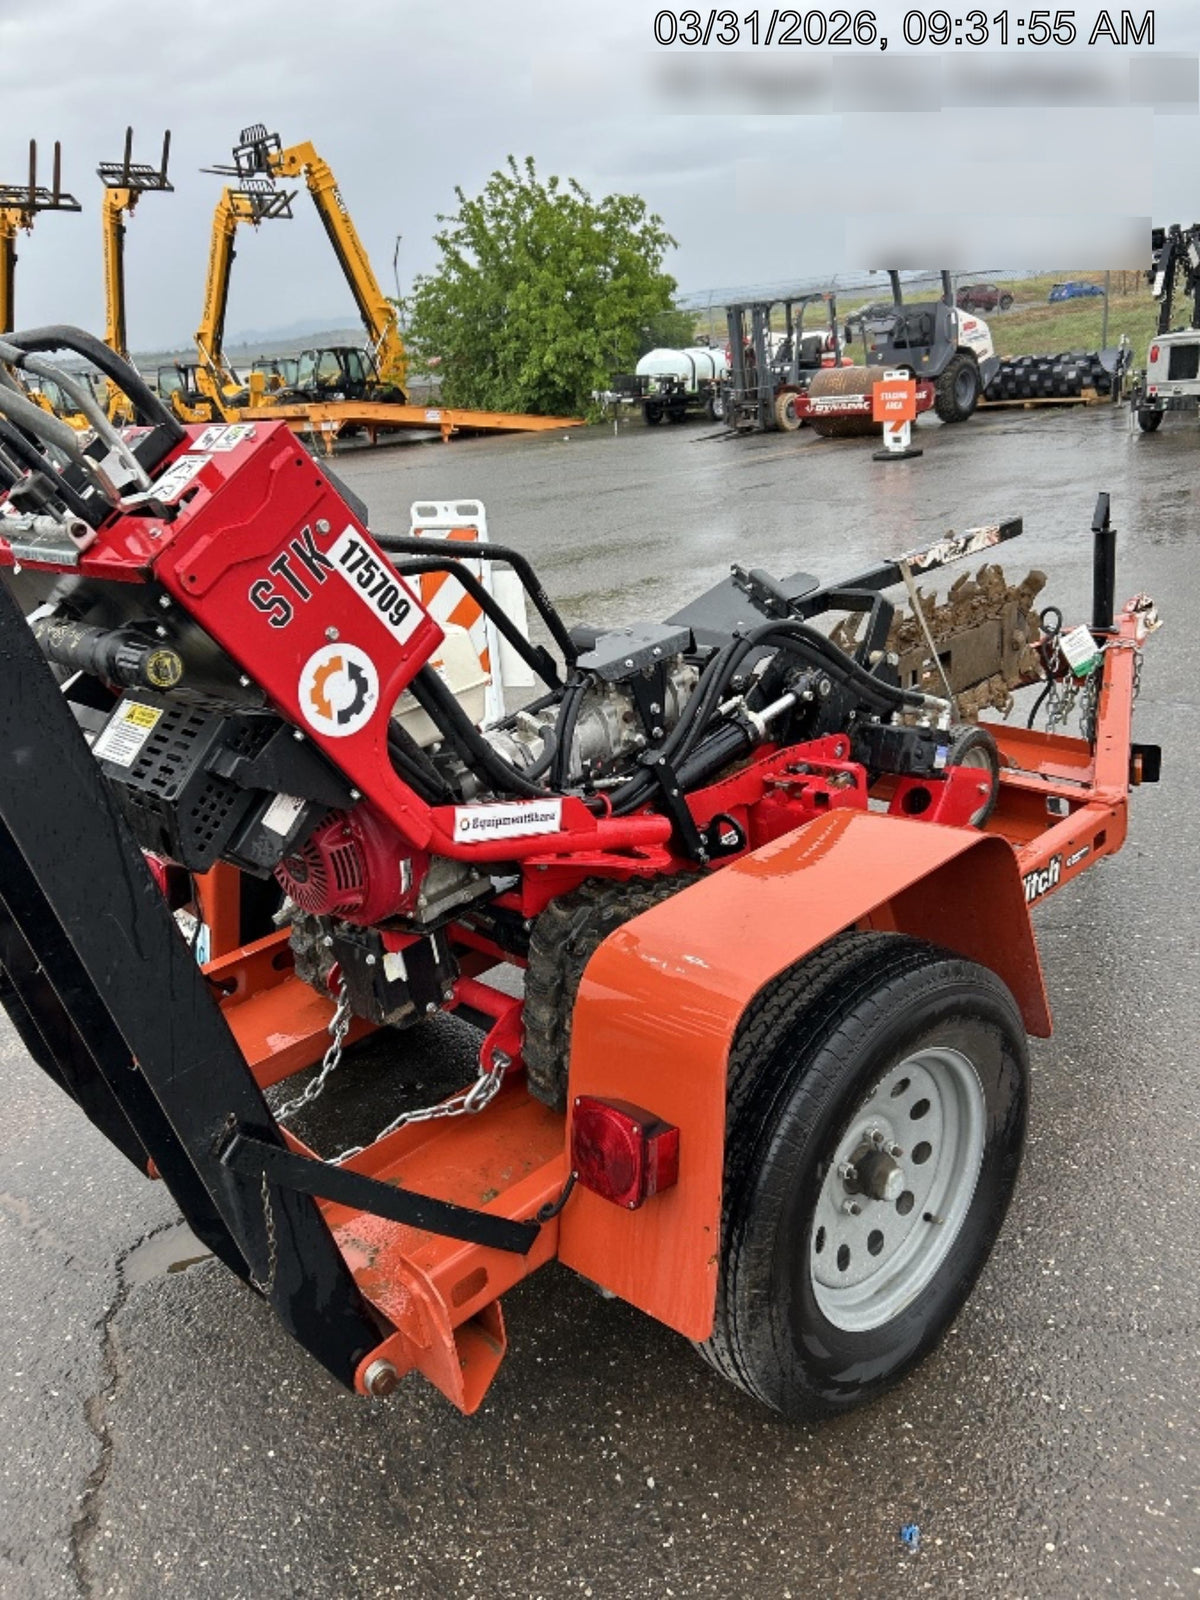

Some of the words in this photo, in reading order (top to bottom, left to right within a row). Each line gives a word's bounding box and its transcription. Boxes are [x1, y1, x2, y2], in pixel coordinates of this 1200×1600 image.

[885, 401, 903, 410] AREA
[248, 524, 335, 629] STK
[338, 539, 411, 627] 175709
[1023, 853, 1061, 904] itch
